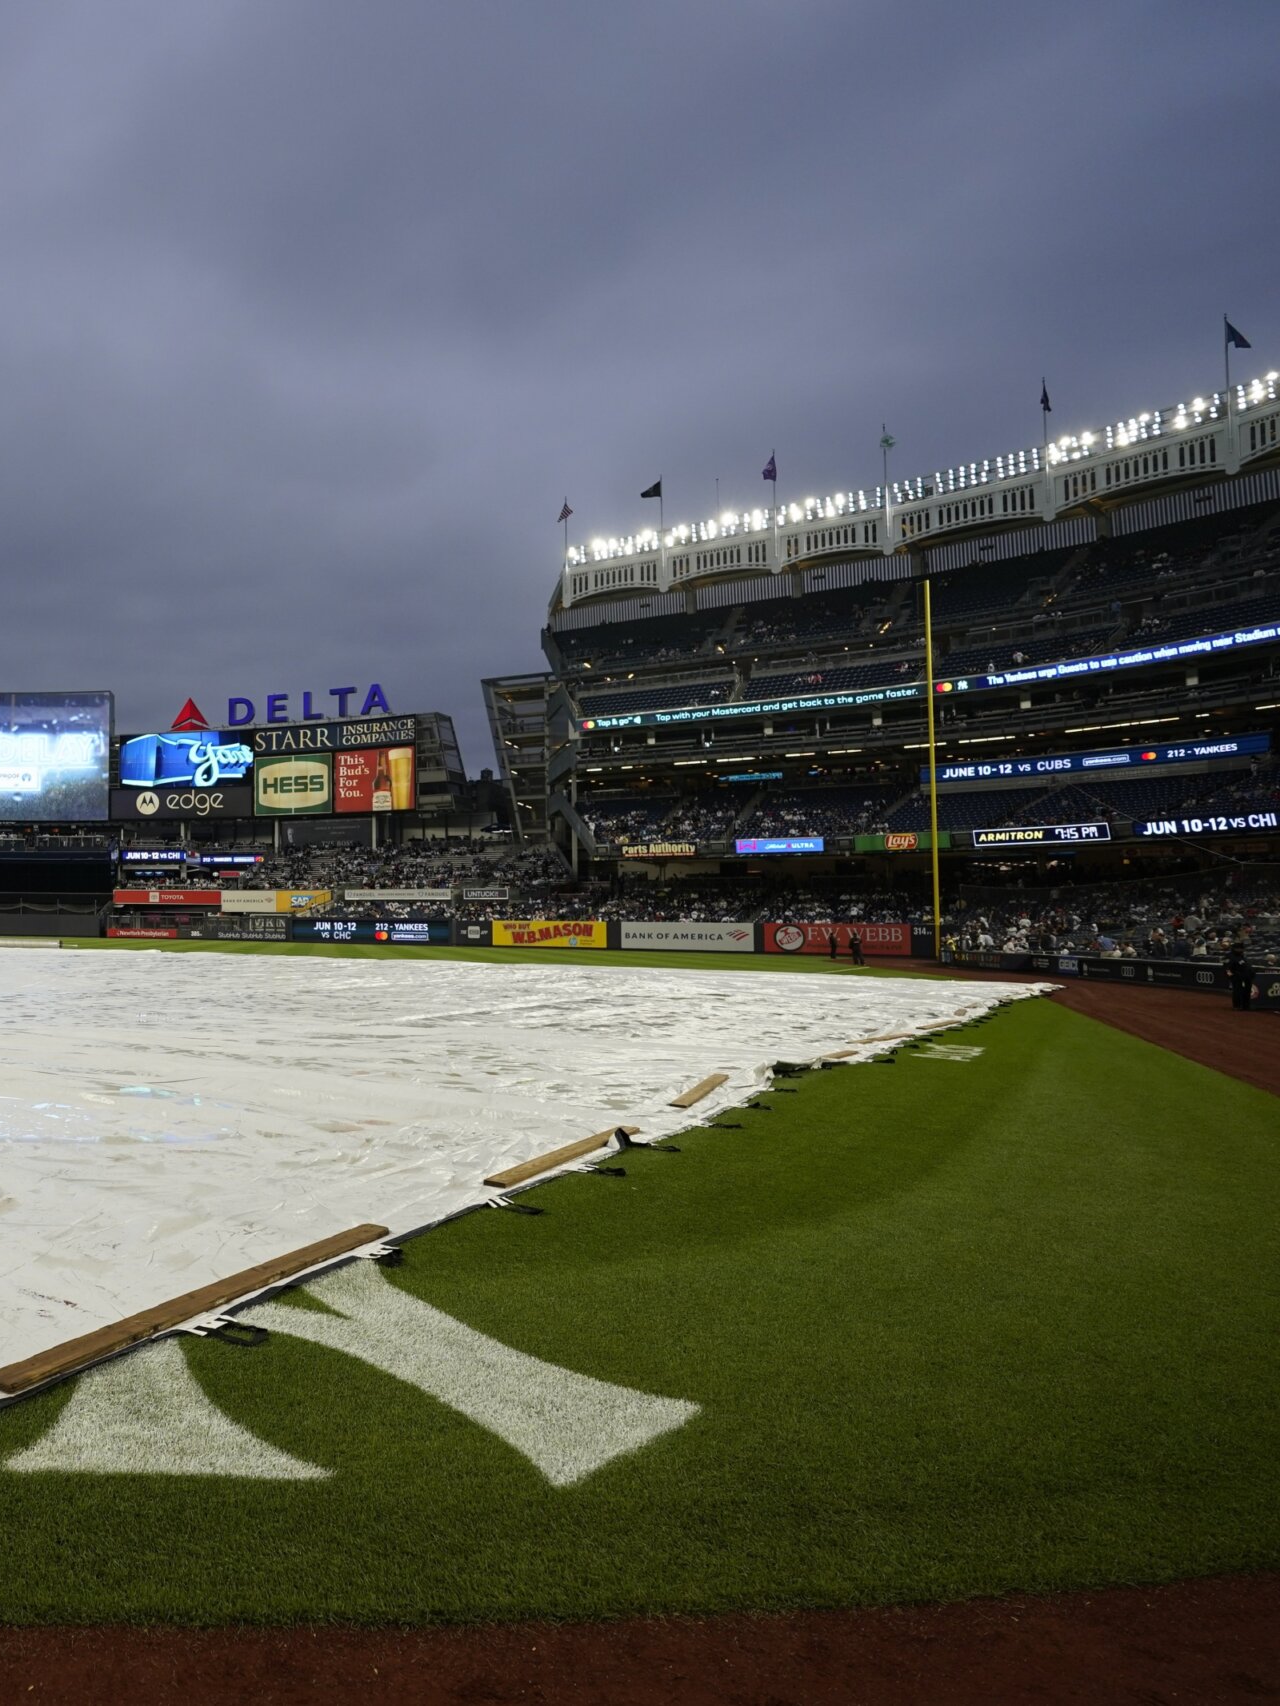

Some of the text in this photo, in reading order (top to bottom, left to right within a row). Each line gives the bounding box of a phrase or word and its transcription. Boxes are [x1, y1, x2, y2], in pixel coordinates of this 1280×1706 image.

[987, 676, 1004, 685] The
[1004, 671, 1037, 682] Yankees
[1038, 668, 1057, 678] urge
[1058, 662, 1088, 674] Guests
[1089, 661, 1099, 669] to
[1100, 659, 1117, 667] use
[1119, 652, 1153, 664] caution
[1153, 647, 1178, 659] when
[1179, 641, 1212, 654] moving
[1212, 636, 1234, 648] near
[1234, 629, 1276, 643] Stadium
[228, 683, 390, 727] DELTA
[656, 688, 918, 722] Tap with your Mastercard and get back to the game faster.
[343, 718, 415, 735] INSURANCE
[597, 719, 611, 727] Tap
[254, 728, 333, 752] STARR
[342, 730, 415, 745] COMPANIES
[338, 755, 364, 765] This
[943, 766, 975, 778] JUNE
[978, 764, 1012, 776] 10-12
[1037, 759, 1071, 771] CUBS
[1085, 756, 1126, 765] yankees.com
[1167, 750, 1185, 758] 212
[1193, 743, 1237, 756] YANKEES
[339, 765, 370, 777] Bud's
[263, 775, 324, 794] HESS
[339, 777, 358, 787] For
[339, 788, 363, 798] You.
[166, 789, 224, 816] edge
[1143, 821, 1178, 835] JUN
[1181, 817, 1228, 832] 10-12
[1248, 813, 1277, 828] CHI
[887, 834, 915, 848] Lay's
[979, 827, 1098, 842] ARMITRON 7:15 PM
[622, 843, 696, 854] Parts Authority
[291, 897, 309, 906] SAP
[314, 922, 357, 931] JUN 10-12
[913, 927, 926, 935] 314
[334, 932, 351, 940] CHC
[807, 927, 902, 942] F.W. WEBB
